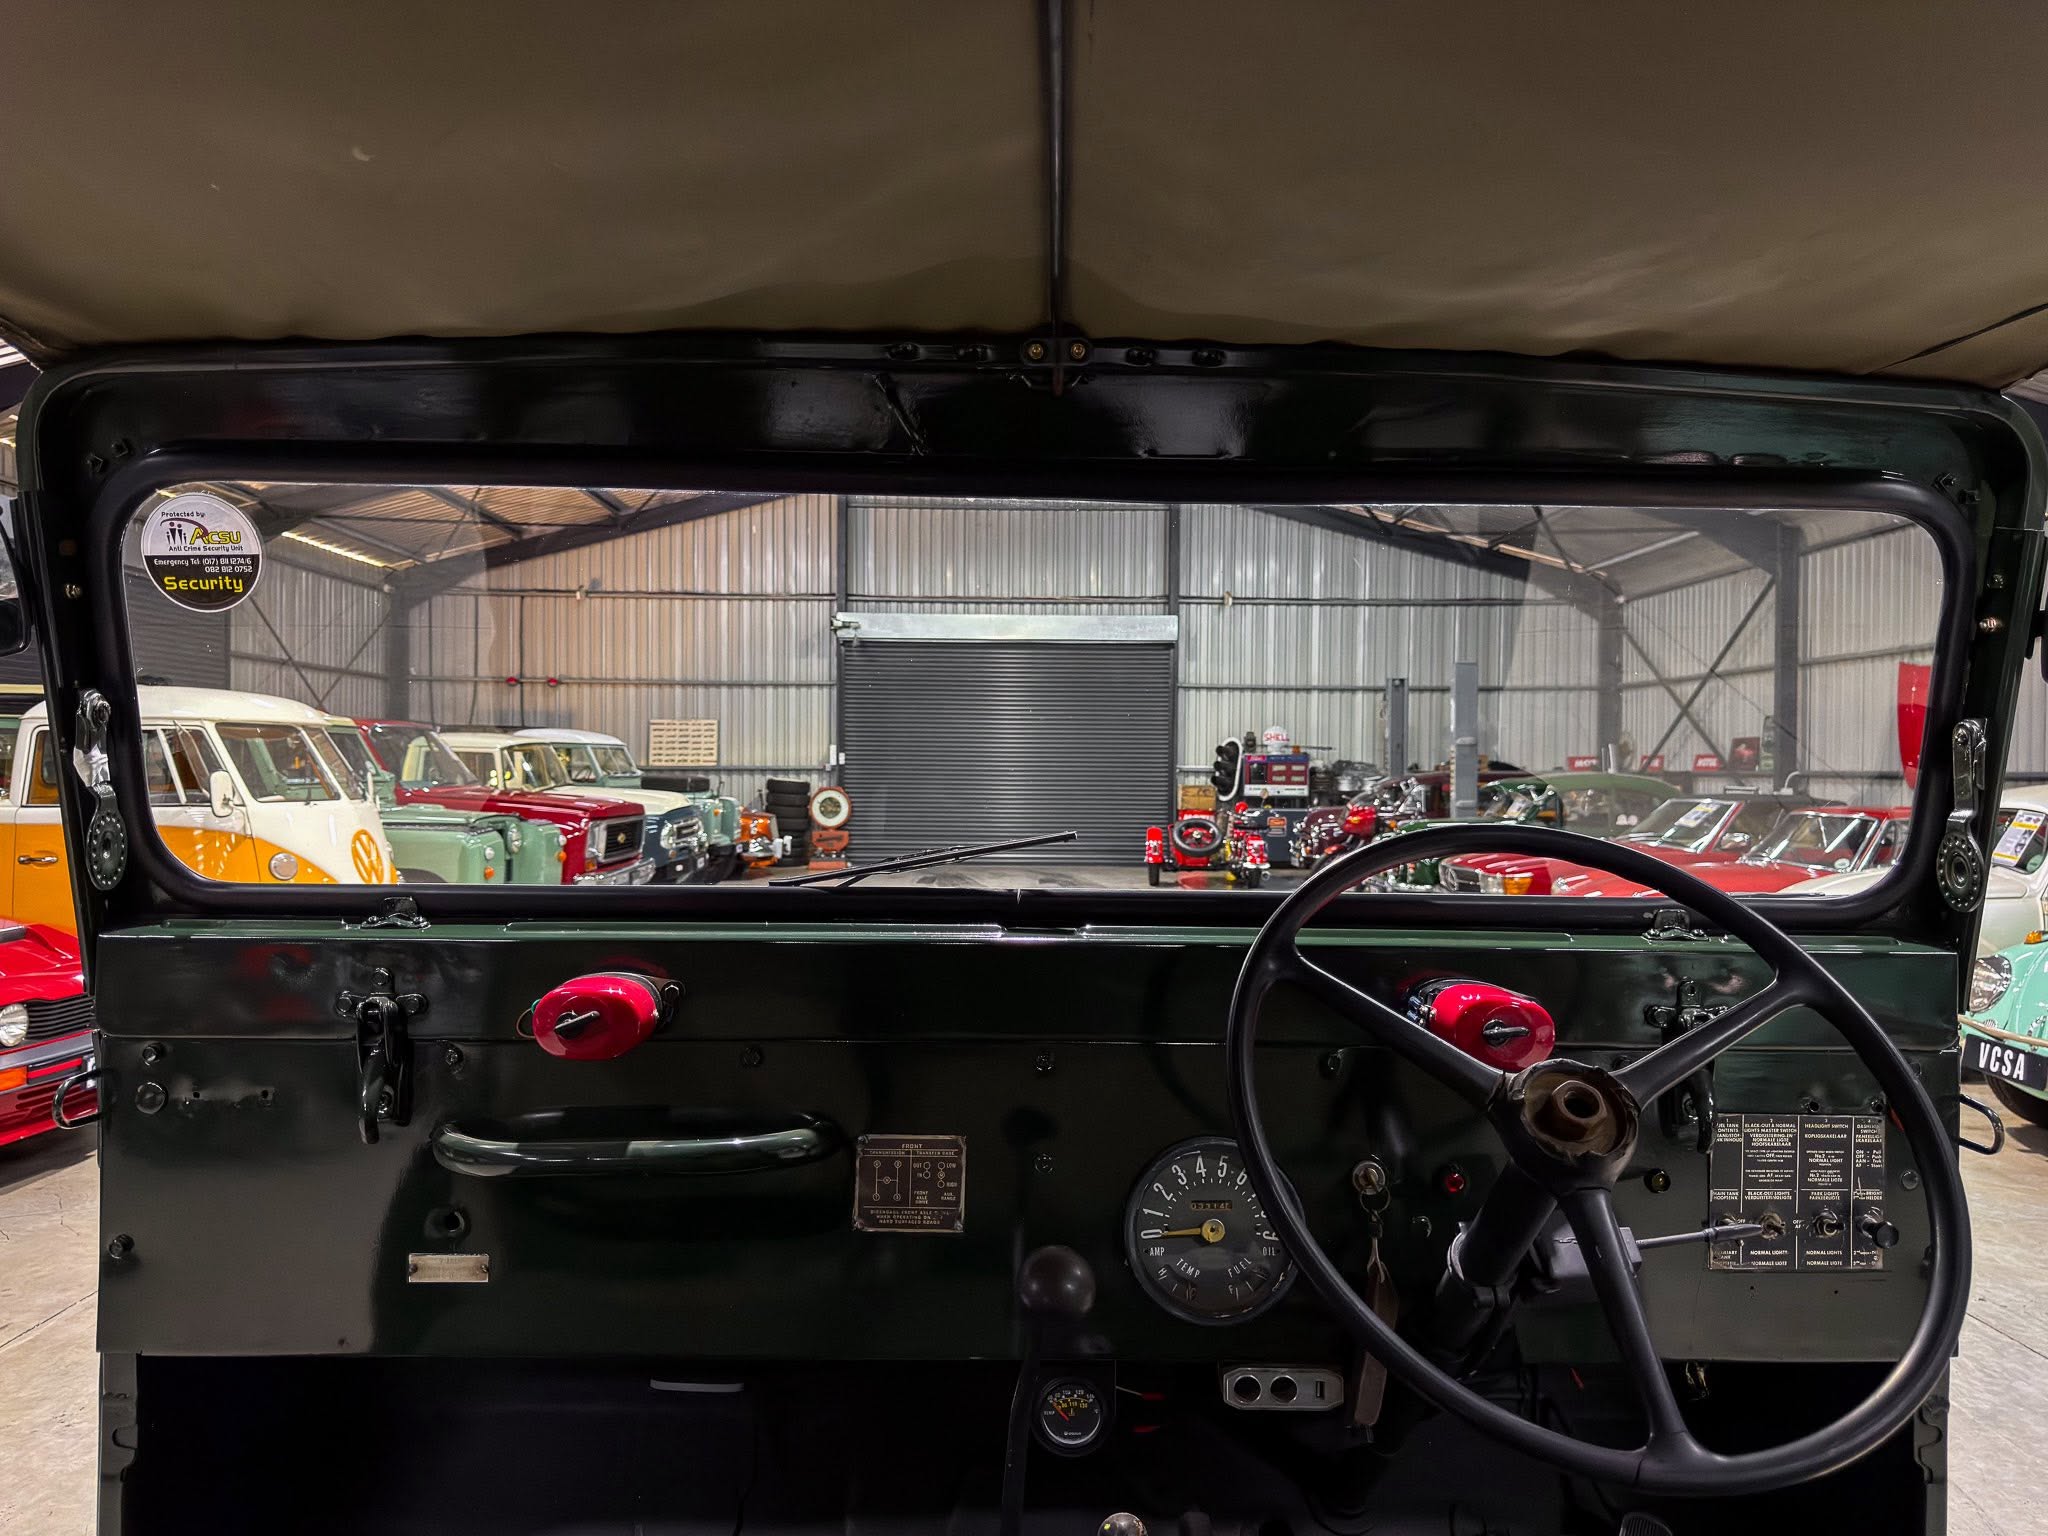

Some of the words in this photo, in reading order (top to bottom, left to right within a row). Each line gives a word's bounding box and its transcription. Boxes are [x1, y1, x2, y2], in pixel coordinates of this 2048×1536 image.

[164, 576, 243, 592] Security
[1264, 732, 1290, 742] SHELL
[1979, 1042, 2025, 1080] VCSA
[1172, 1164, 1187, 1185] 3
[1196, 1156, 1206, 1177] 4
[1218, 1155, 1229, 1177] 5
[1236, 1168, 1248, 1185] 6
[1153, 1182, 1174, 1201] 2
[1143, 1208, 1164, 1216] 1
[1141, 1228, 1162, 1239] 0
[1150, 1247, 1165, 1256] AMP
[1263, 1247, 1276, 1256] OIL
[1177, 1258, 1200, 1278] TEMP
[1228, 1258, 1252, 1278] FUEL
